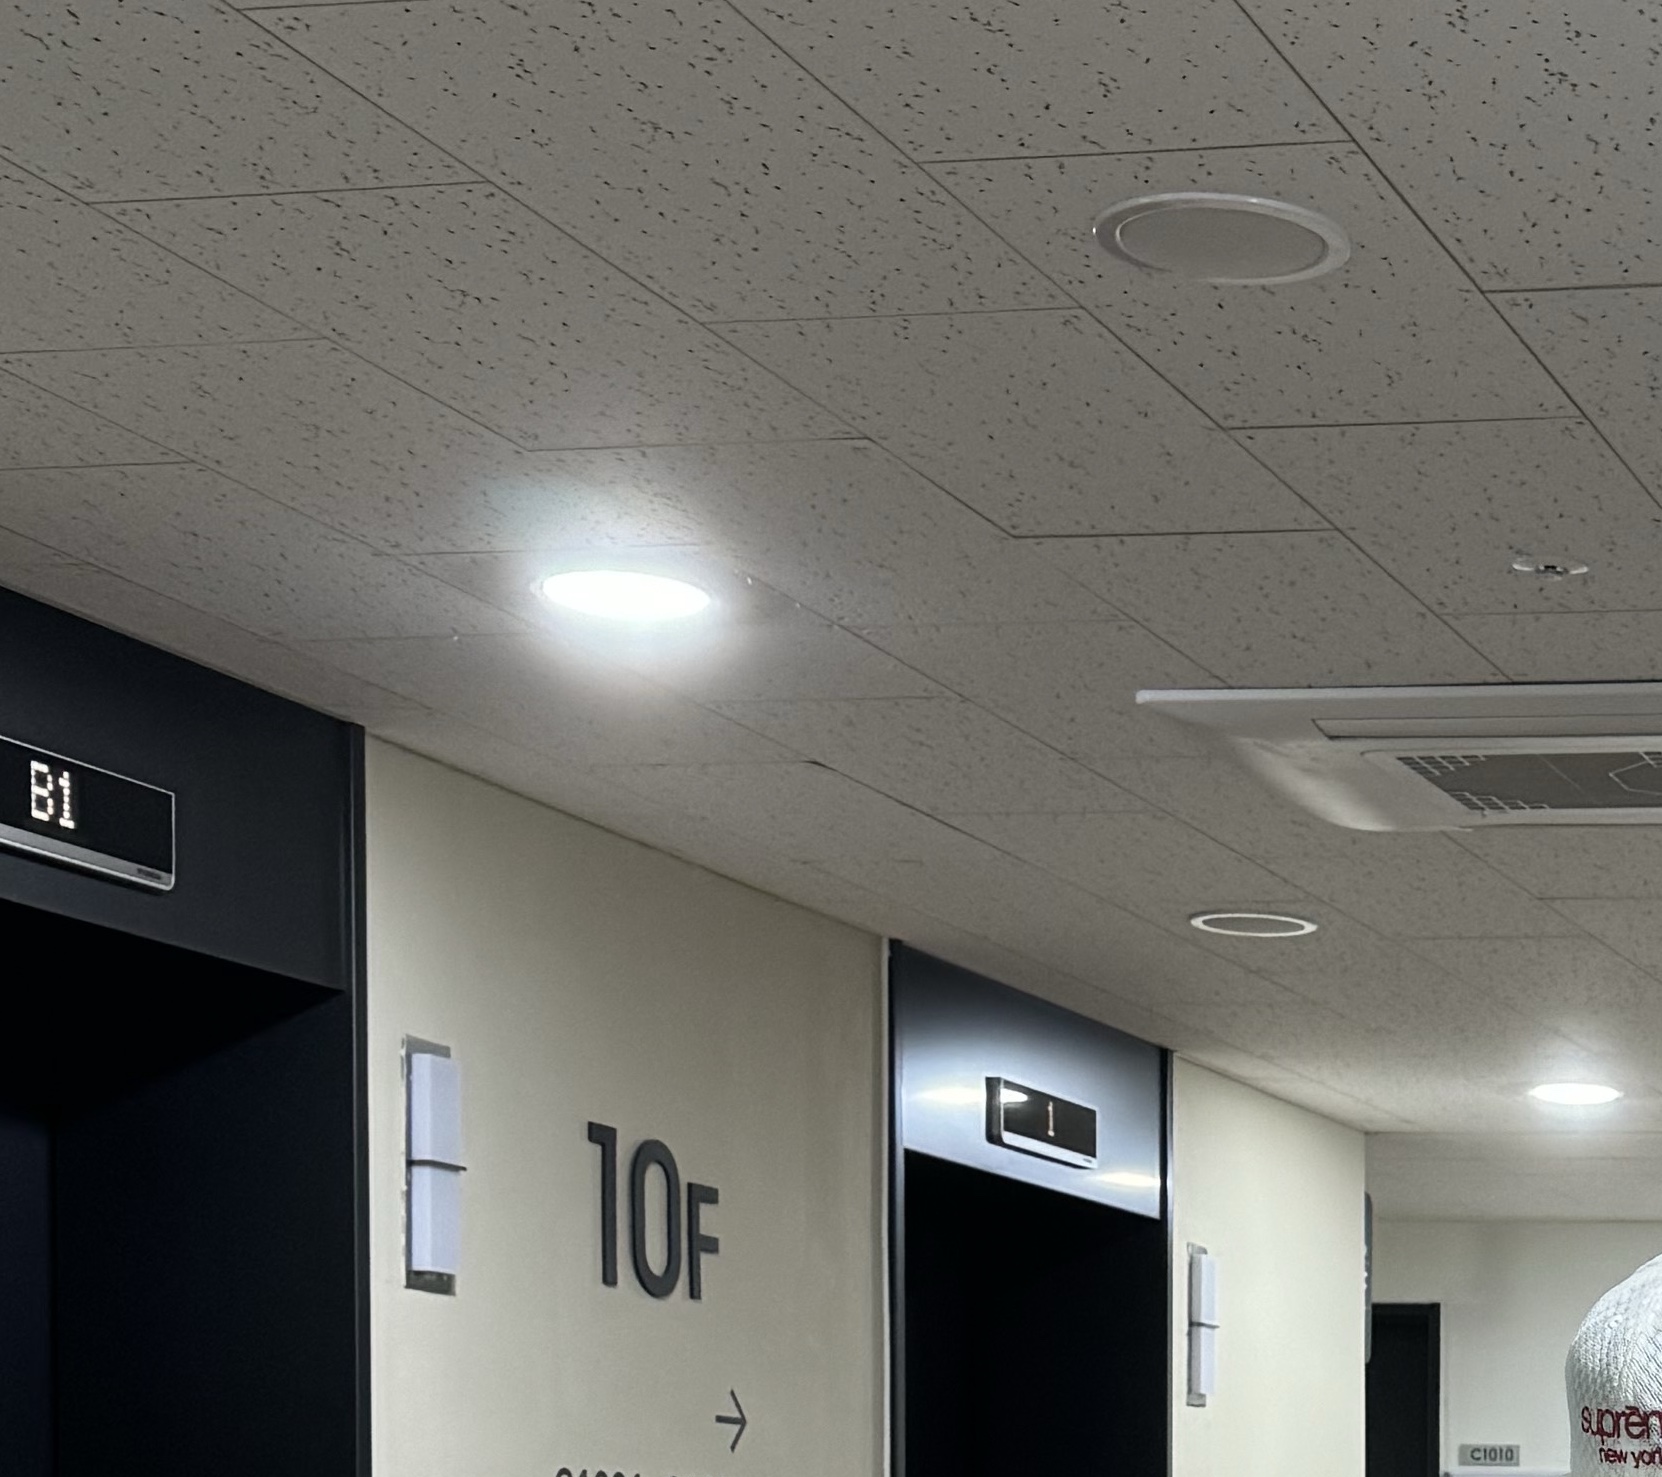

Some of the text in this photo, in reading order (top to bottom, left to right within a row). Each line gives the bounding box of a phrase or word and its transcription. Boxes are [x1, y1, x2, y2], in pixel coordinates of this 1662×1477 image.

[30, 760, 75, 830] B1
[587, 1121, 719, 1301] 10F
[1470, 1447, 1514, 1462] C1010
[1599, 1448, 1628, 1464] new
